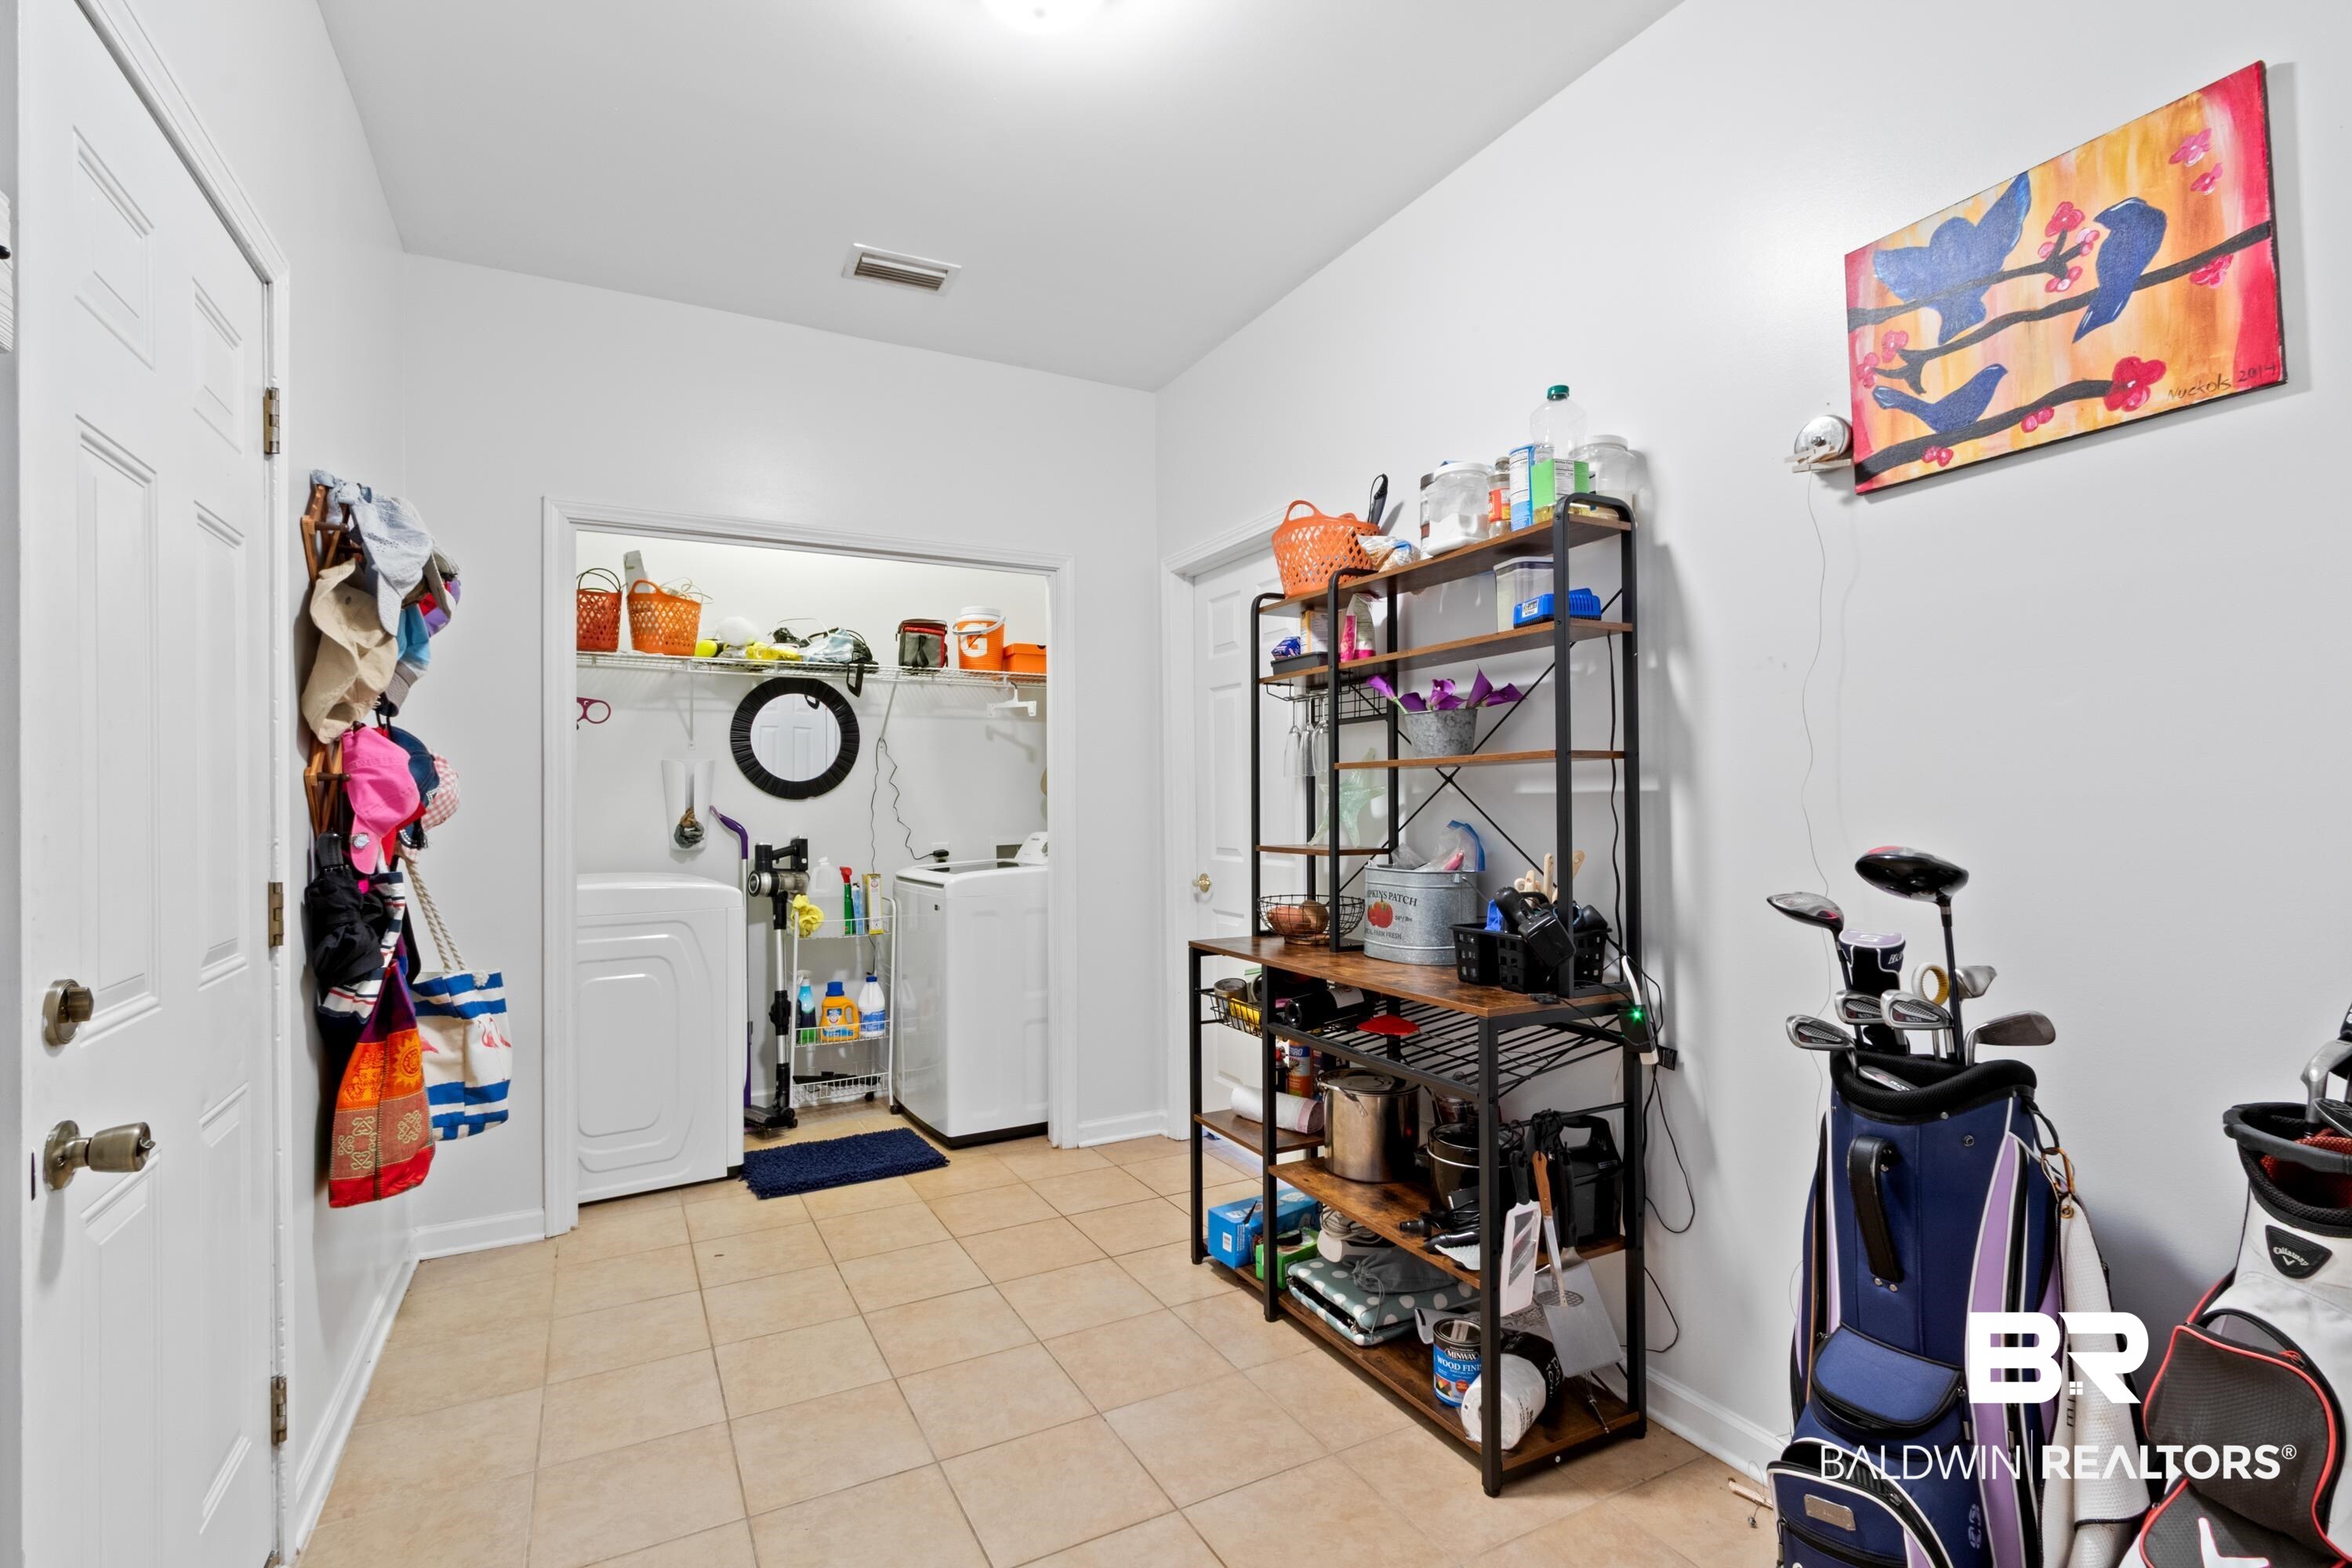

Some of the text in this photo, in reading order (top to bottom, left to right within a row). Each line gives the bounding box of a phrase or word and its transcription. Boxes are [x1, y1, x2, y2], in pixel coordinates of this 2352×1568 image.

[1388, 891, 1417, 906] PATCH
[2273, 1247, 2309, 1266] Callaway
[1436, 1355, 1461, 1370] WOOD
[1447, 1350, 1476, 1360] MINWAX
